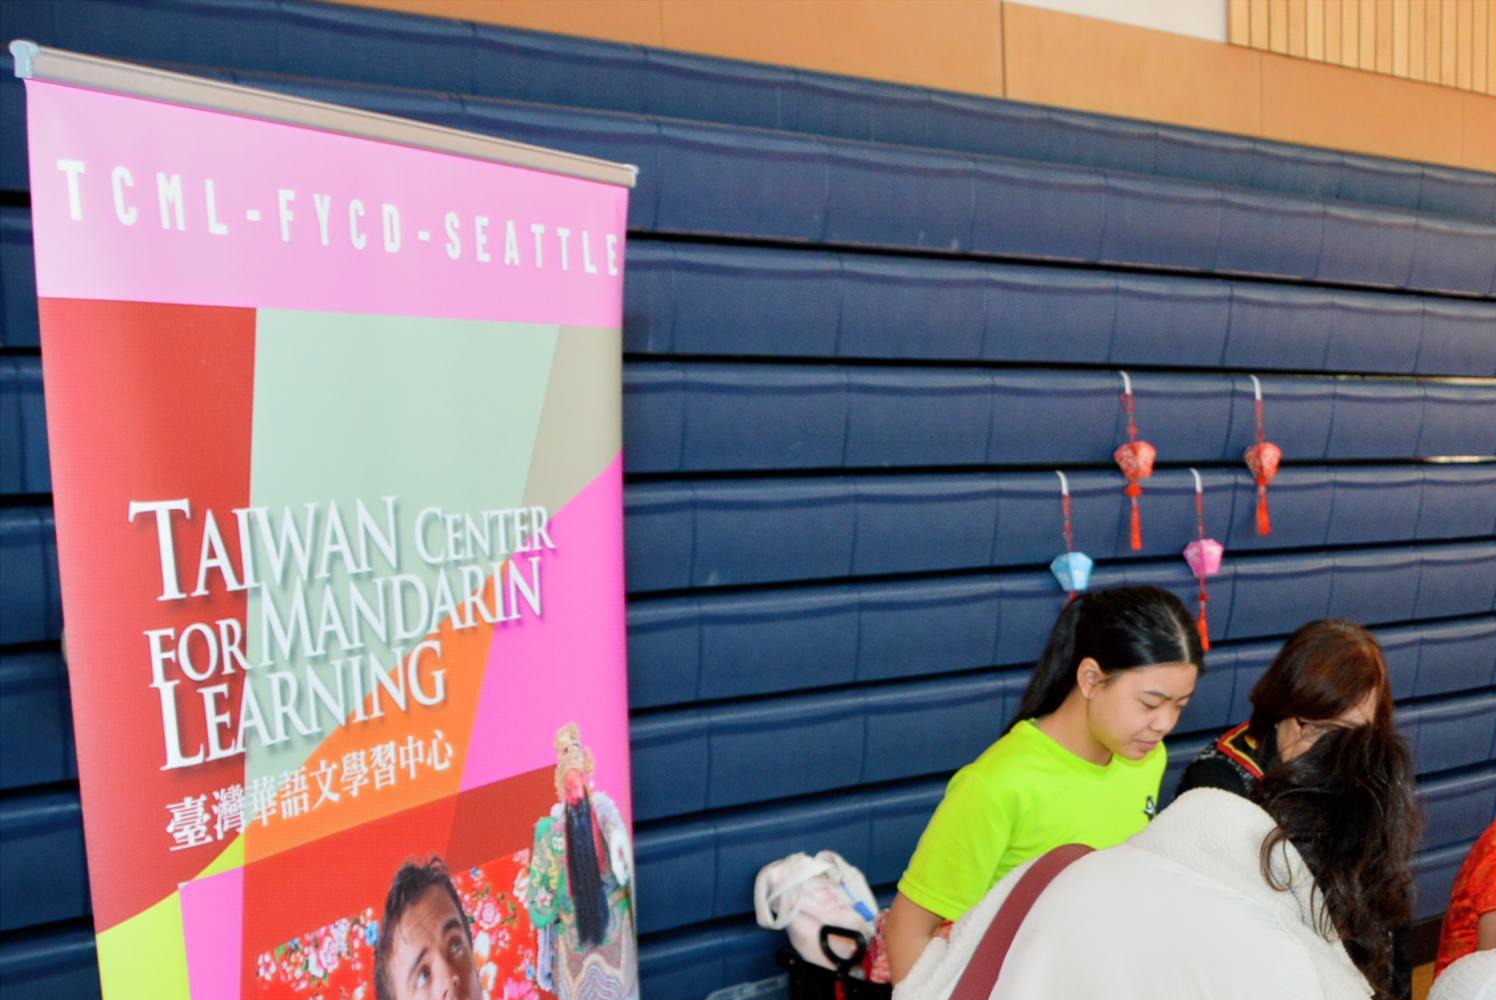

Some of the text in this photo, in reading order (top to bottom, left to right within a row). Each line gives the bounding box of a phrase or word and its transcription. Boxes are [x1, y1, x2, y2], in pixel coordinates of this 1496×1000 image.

[57, 159, 619, 276] TCML-FYCD-SEATTLE
[128, 496, 556, 602] TAIWAN CENTER
[144, 556, 544, 688] FOR MANDARIN
[152, 640, 447, 772] LEARNING
[165, 728, 454, 852] 臺灣華語文學習中心
